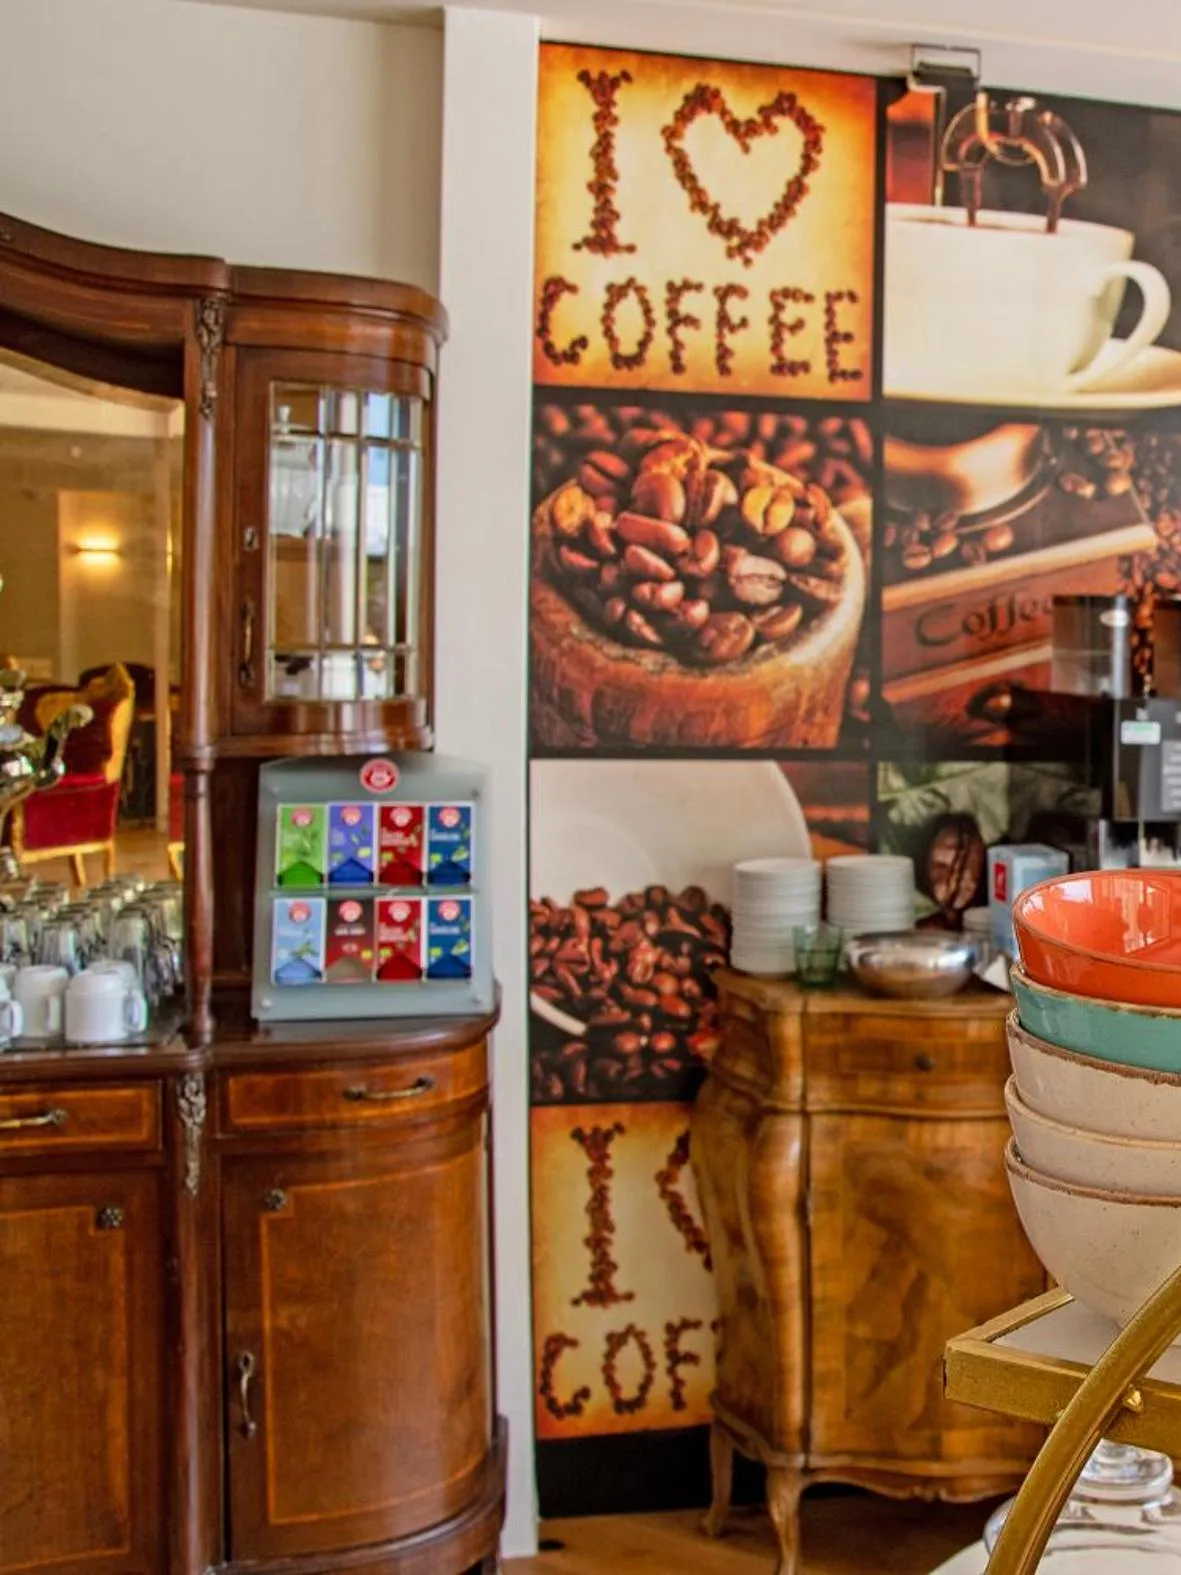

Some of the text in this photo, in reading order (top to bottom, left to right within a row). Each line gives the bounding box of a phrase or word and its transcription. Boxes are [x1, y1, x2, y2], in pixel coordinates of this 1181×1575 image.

[572, 69, 636, 257] I
[536, 275, 864, 383] COFFEE
[570, 1122, 635, 1309] I
[540, 1317, 719, 1418] COF
